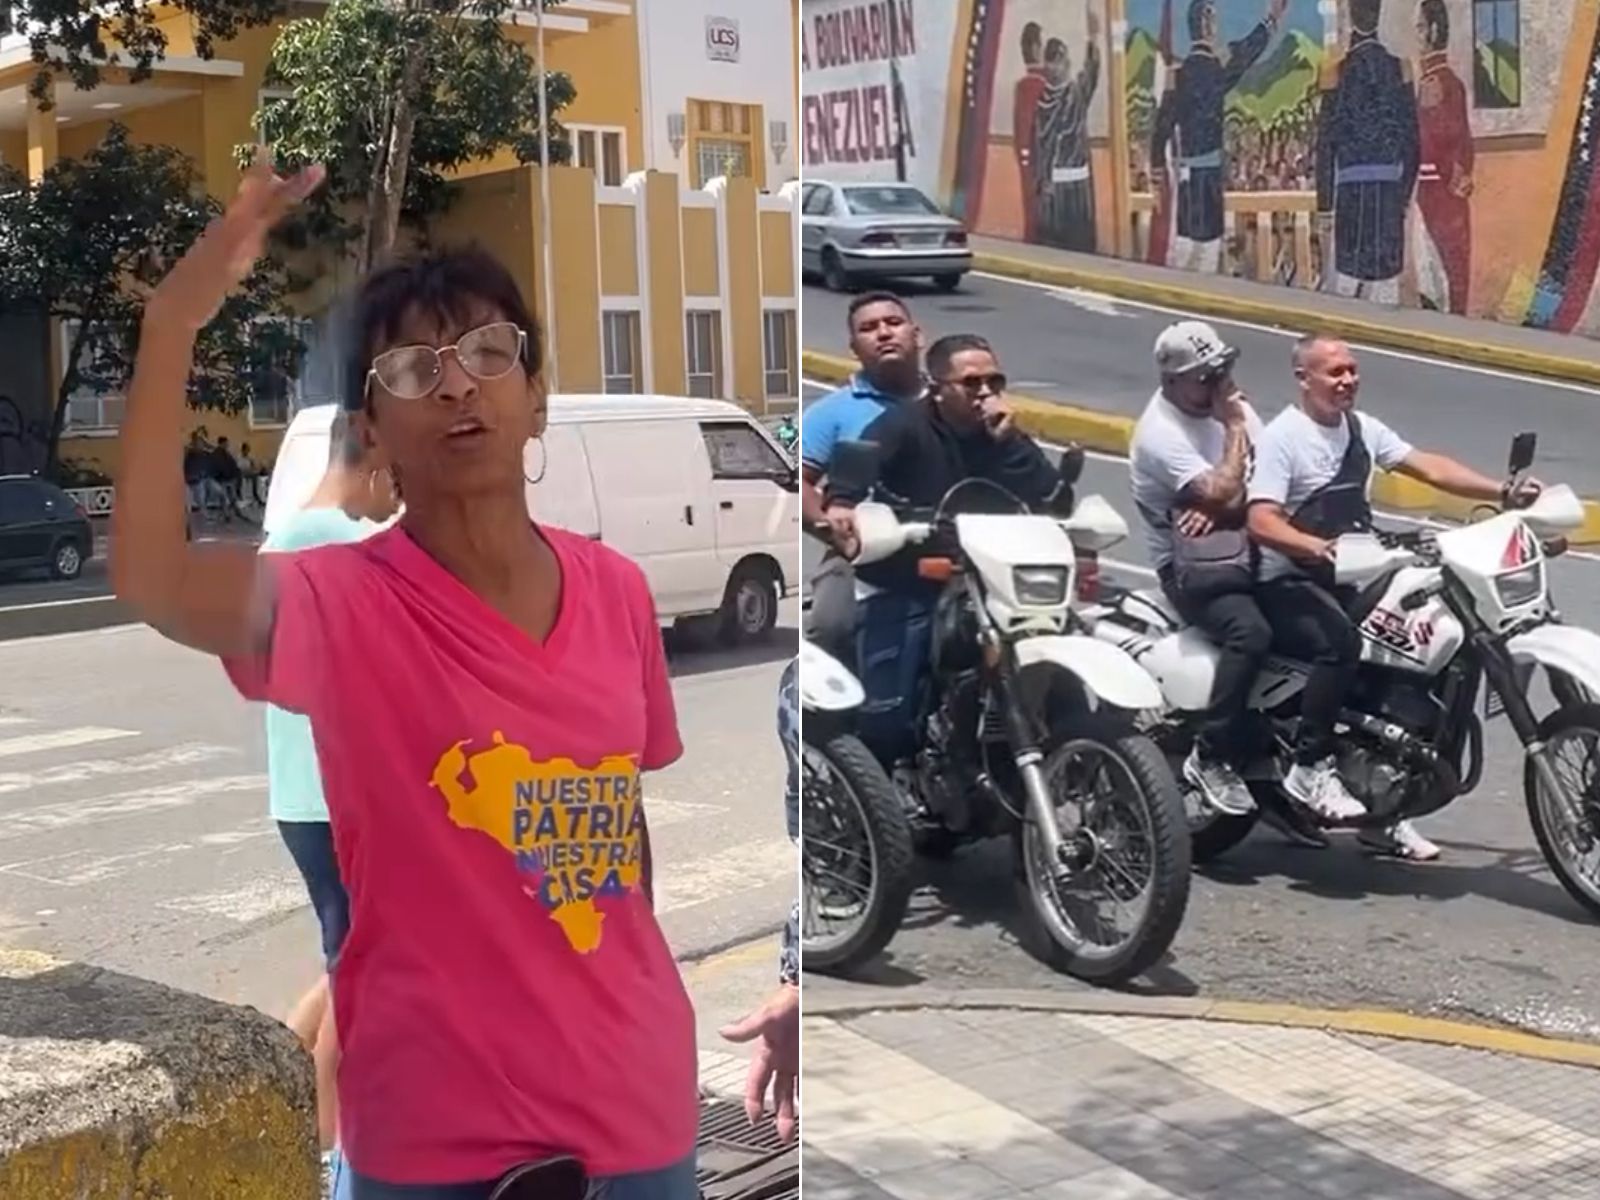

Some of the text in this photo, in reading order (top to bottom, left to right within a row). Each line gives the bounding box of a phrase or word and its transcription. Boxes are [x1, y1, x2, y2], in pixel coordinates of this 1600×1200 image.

[710, 28, 735, 46] UCS
[802, 81, 916, 165] ENEZUELA
[514, 803, 645, 845] PATRIA
[515, 840, 640, 873] NUESTRA
